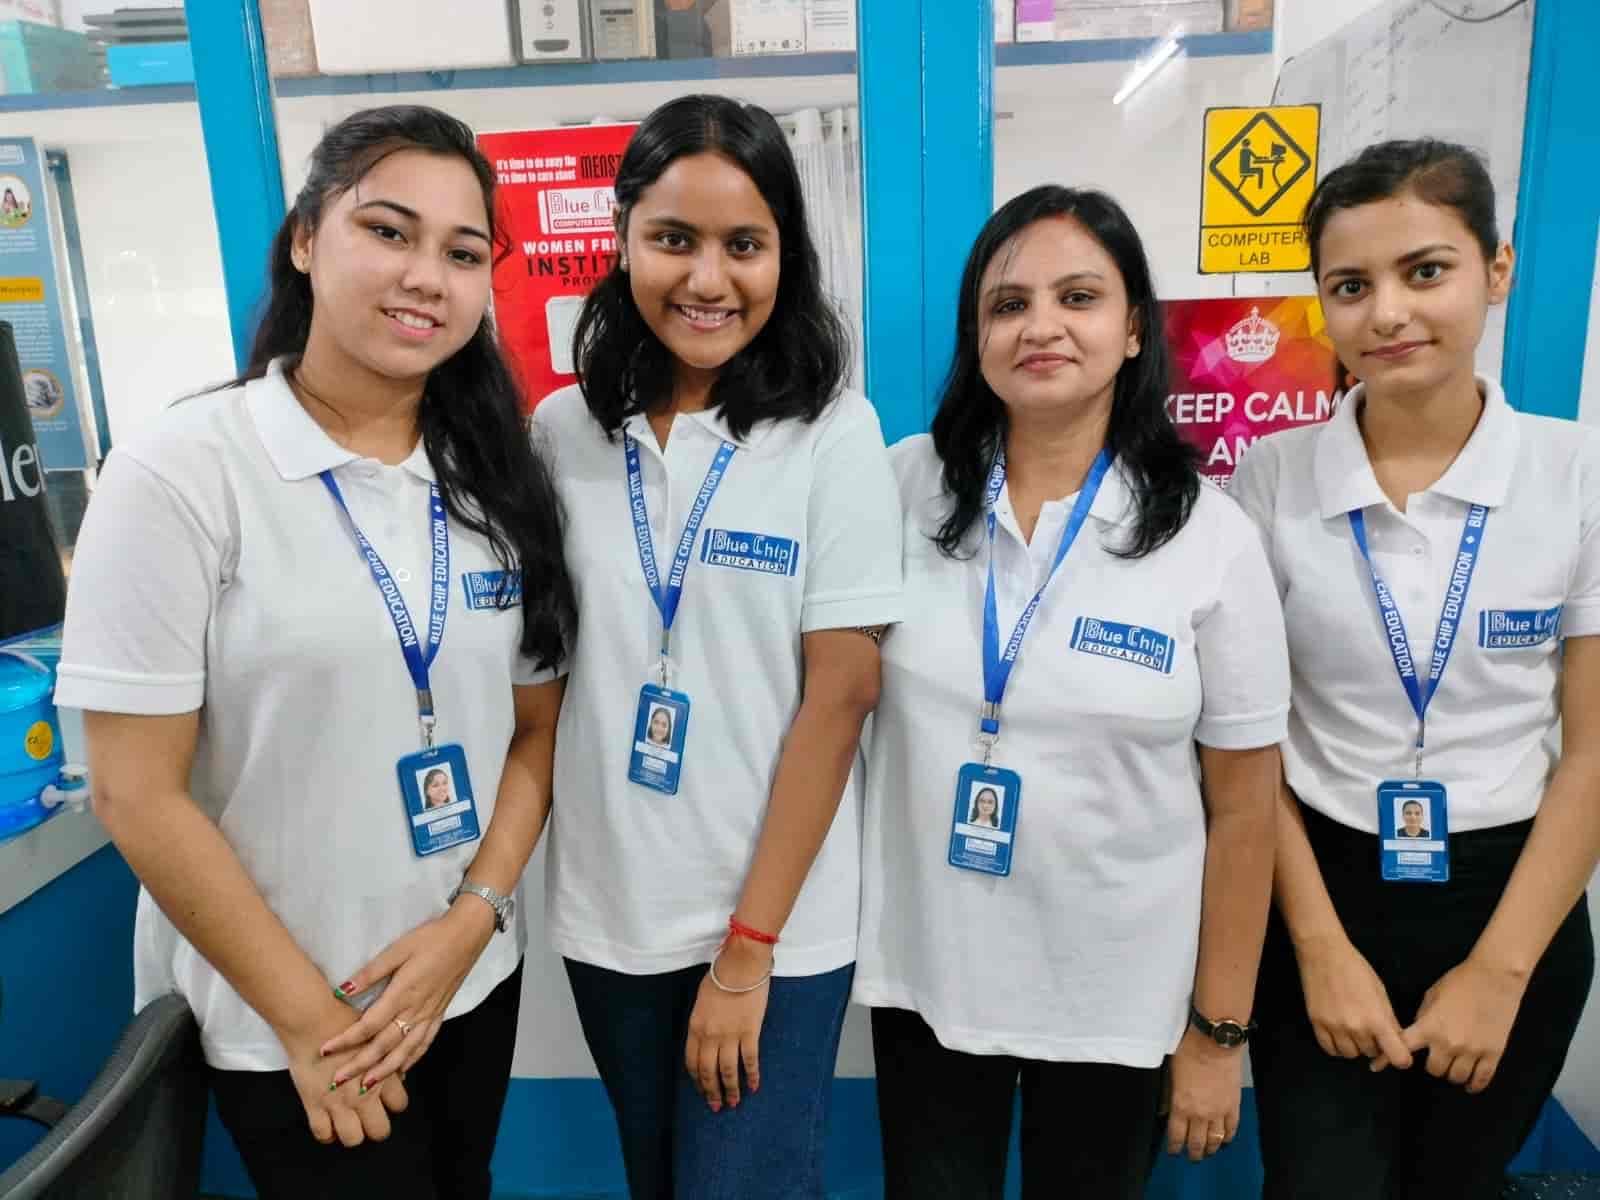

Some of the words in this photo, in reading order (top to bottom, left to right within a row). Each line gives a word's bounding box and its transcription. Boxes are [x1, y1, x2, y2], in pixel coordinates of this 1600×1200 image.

[550, 192, 590, 213] Blue
[522, 240, 585, 255] WOMEN
[1208, 231, 1305, 247] COMPUTER
[1240, 252, 1270, 265] LAB
[630, 470, 642, 499] BLUE
[633, 500, 646, 523] CHIP
[687, 469, 721, 529] EDUCATION
[433, 519, 447, 582] EDUCATION
[637, 526, 658, 587] EDUCATION
[678, 532, 694, 557] CHIP
[713, 530, 750, 553] Blue
[753, 536, 789, 563] Chip
[670, 559, 687, 587] BLUE
[711, 554, 785, 572] EDUCATION
[367, 550, 386, 576] CHIP
[380, 577, 417, 648] EDUCATION
[433, 583, 446, 611] CHIP
[1376, 582, 1393, 609] CHIP
[1444, 551, 1473, 620] EDUCATION
[430, 612, 445, 644] BLUE
[1436, 622, 1454, 647] CHIP
[1491, 612, 1531, 632] Blue
[1085, 620, 1123, 643] Blue
[1128, 627, 1165, 658] Chip
[1384, 609, 1415, 677] EDUCATION
[1081, 641, 1161, 669] EDUCATION
[1431, 649, 1446, 681] BLUE
